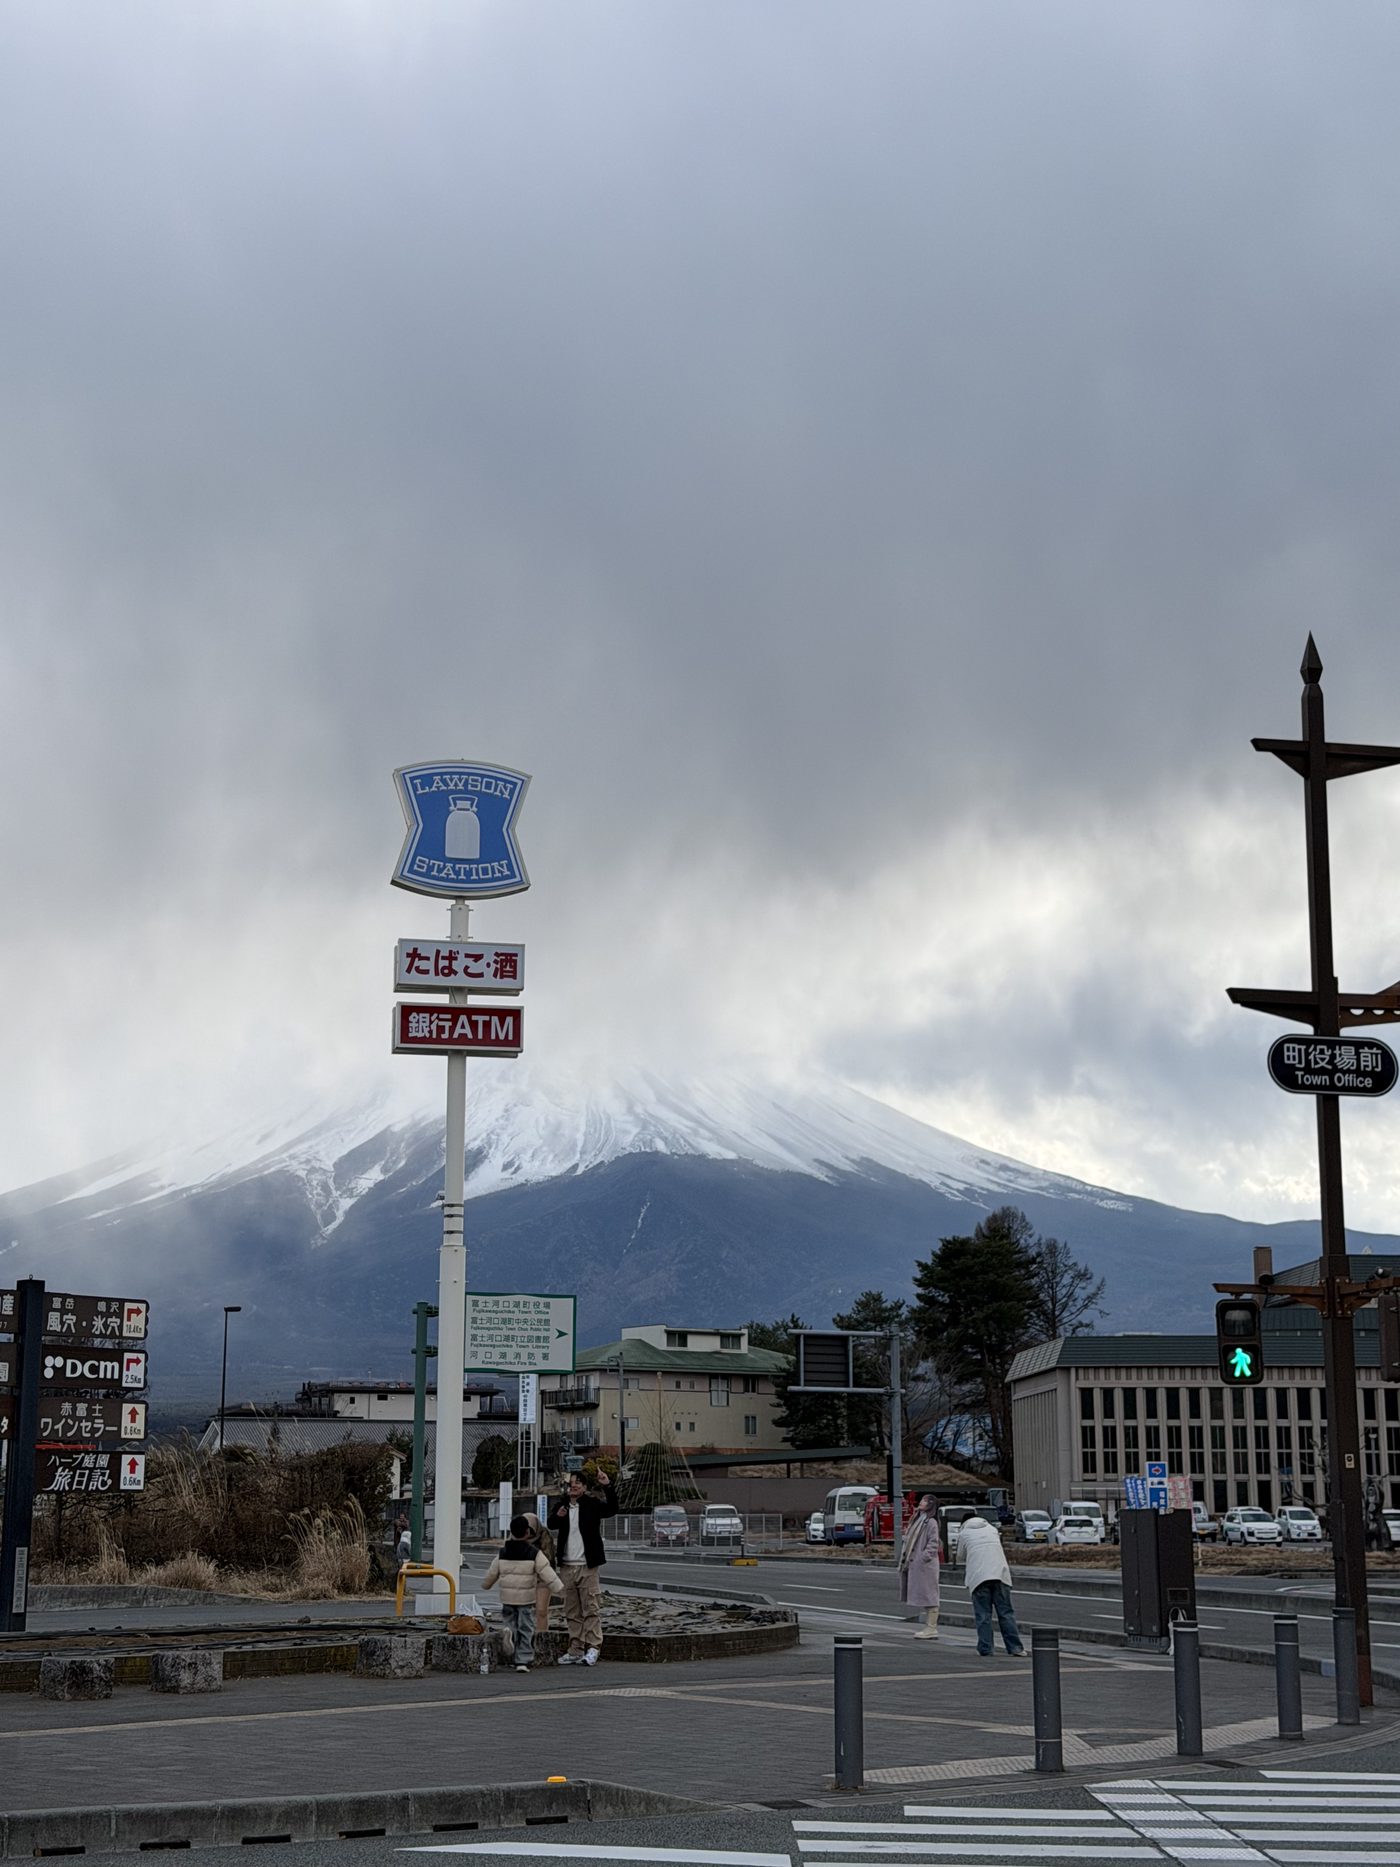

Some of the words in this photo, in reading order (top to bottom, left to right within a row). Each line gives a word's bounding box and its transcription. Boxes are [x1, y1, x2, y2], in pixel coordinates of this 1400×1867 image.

[413, 775, 514, 799] LAWSON
[413, 856, 512, 880] STATION
[405, 946, 519, 981] たばこ・酒
[408, 1012, 514, 1041] 銀行ATM
[1283, 1043, 1383, 1072] 町役場前
[1295, 1071, 1330, 1086] Town
[1334, 1073, 1373, 1088] Office
[471, 1299, 551, 1309] 富士河口湖町役場
[60, 1401, 103, 1417] 赤富士
[41, 1417, 118, 1438] ワインセラー
[47, 1453, 111, 1468] ハーブ庭園
[42, 1466, 113, 1491] 旅日記
[123, 1476, 141, 1487] 0.6Km
